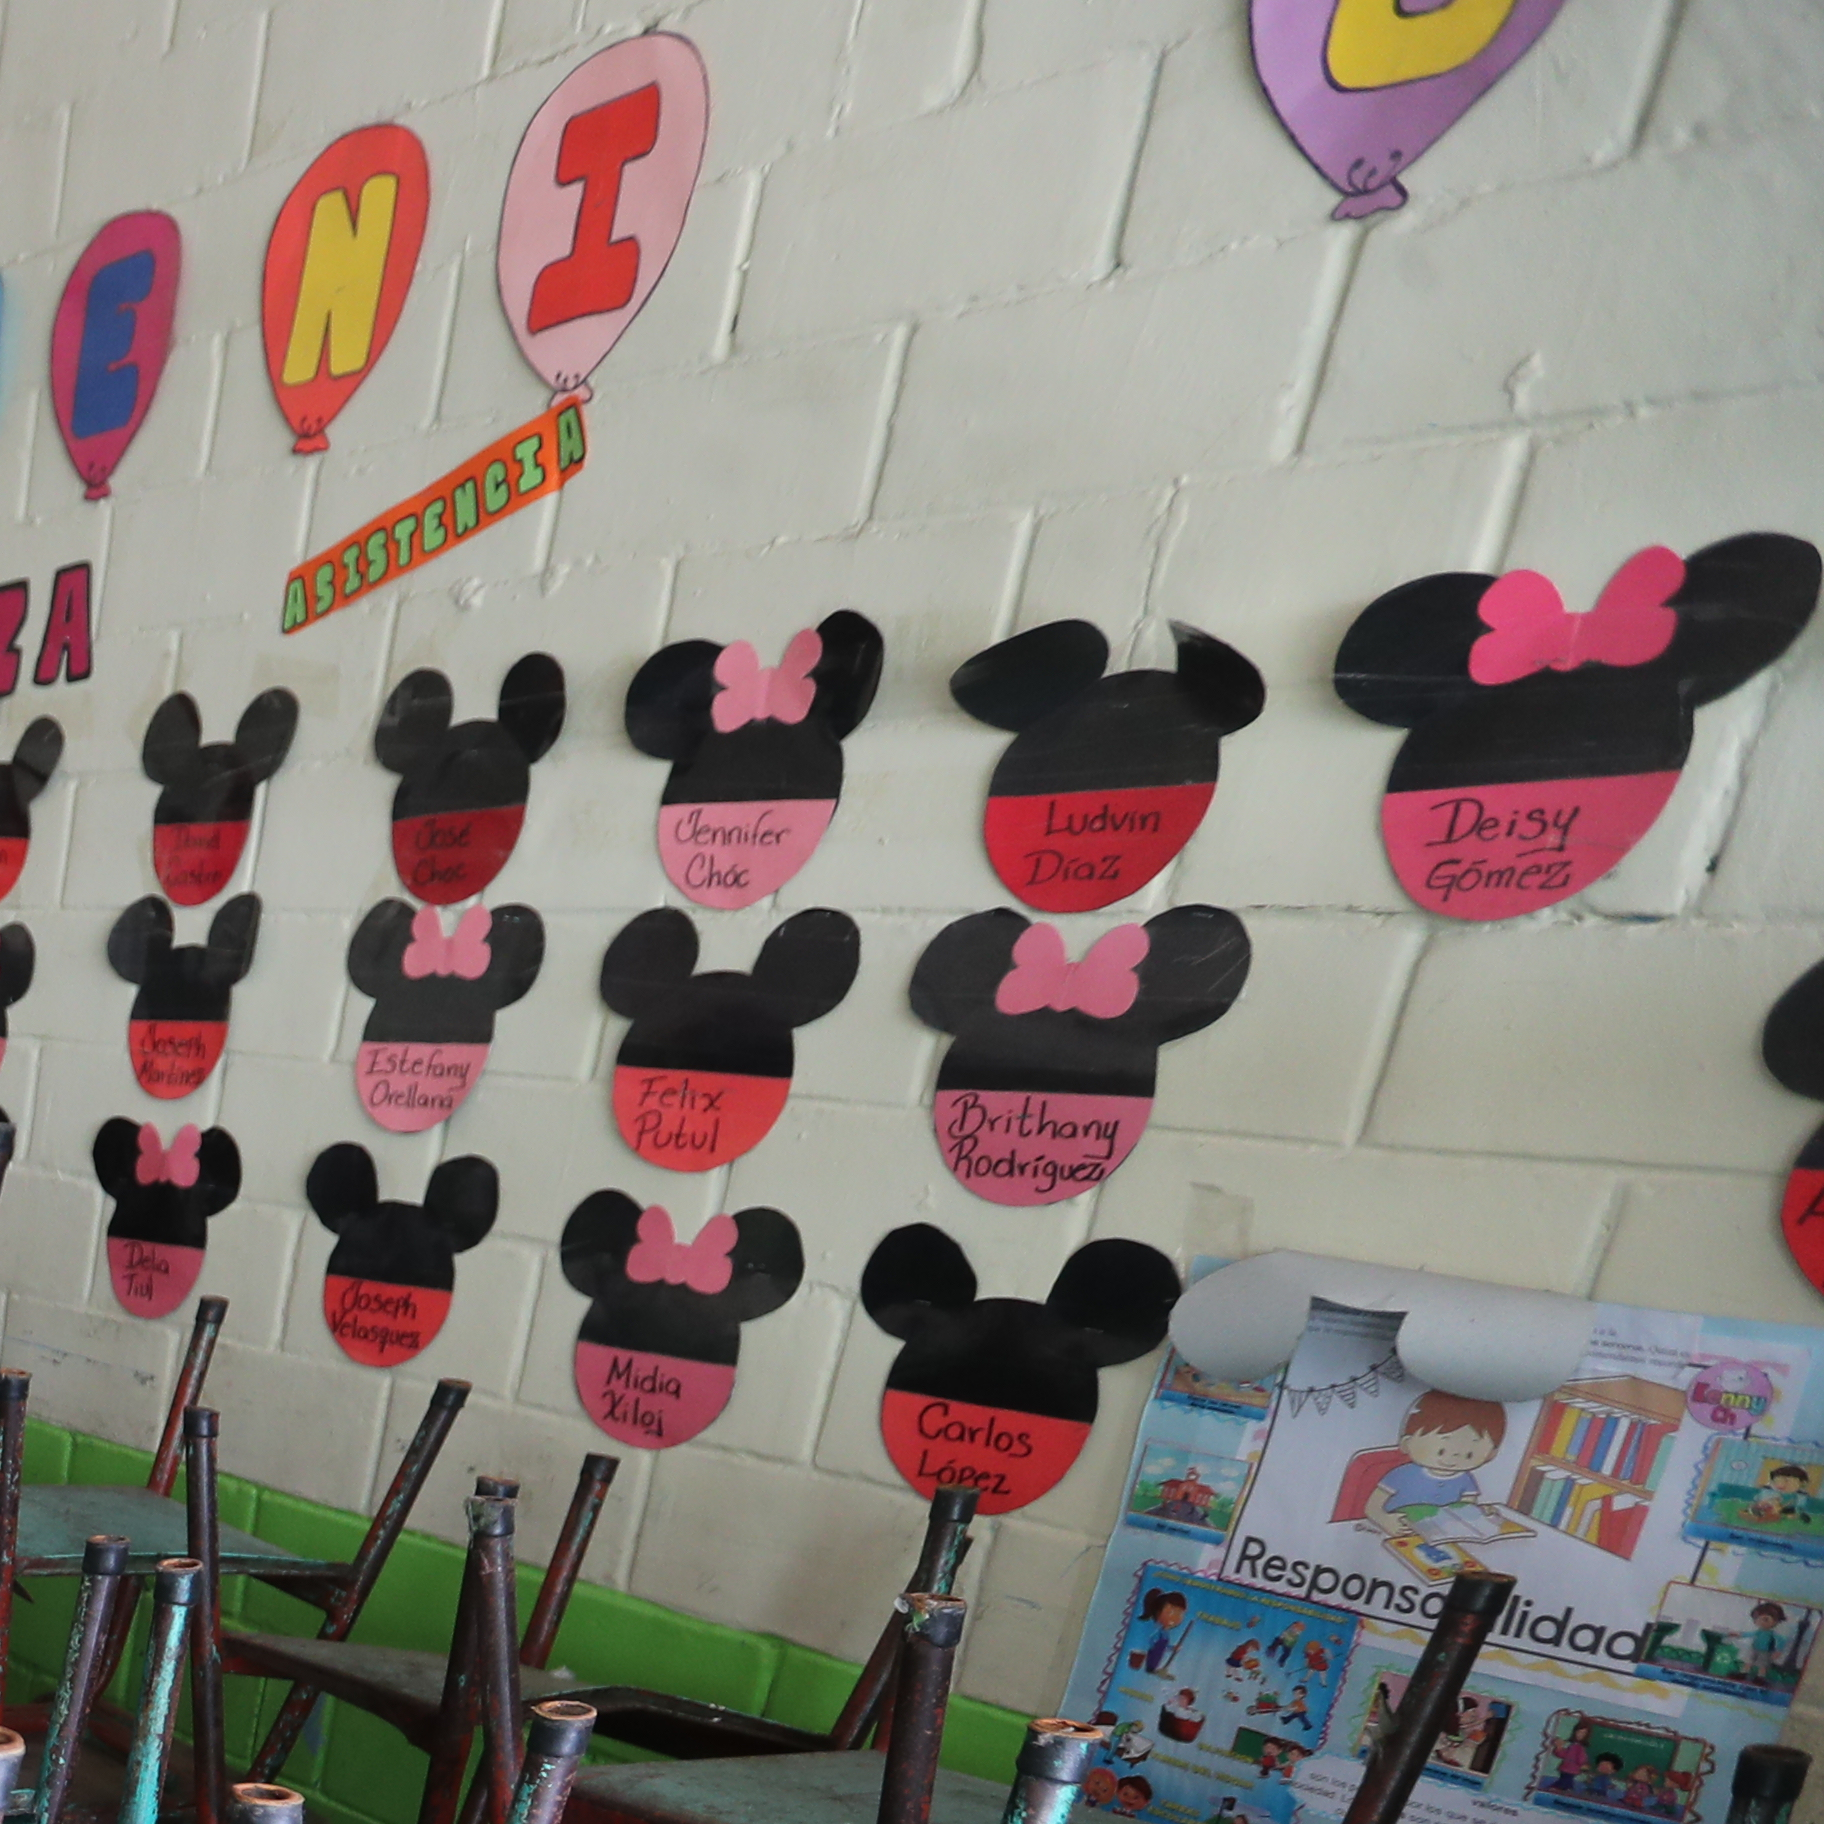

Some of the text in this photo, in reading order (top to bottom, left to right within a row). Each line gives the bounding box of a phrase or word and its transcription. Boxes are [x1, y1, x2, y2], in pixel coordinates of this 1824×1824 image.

[282, 403, 586, 633] ASISTENCIA
[675, 808, 792, 846] Jennifer
[1425, 797, 1581, 858] Deisy
[948, 1091, 1121, 1160] Brithany
[917, 1401, 1034, 1458] Carlos
